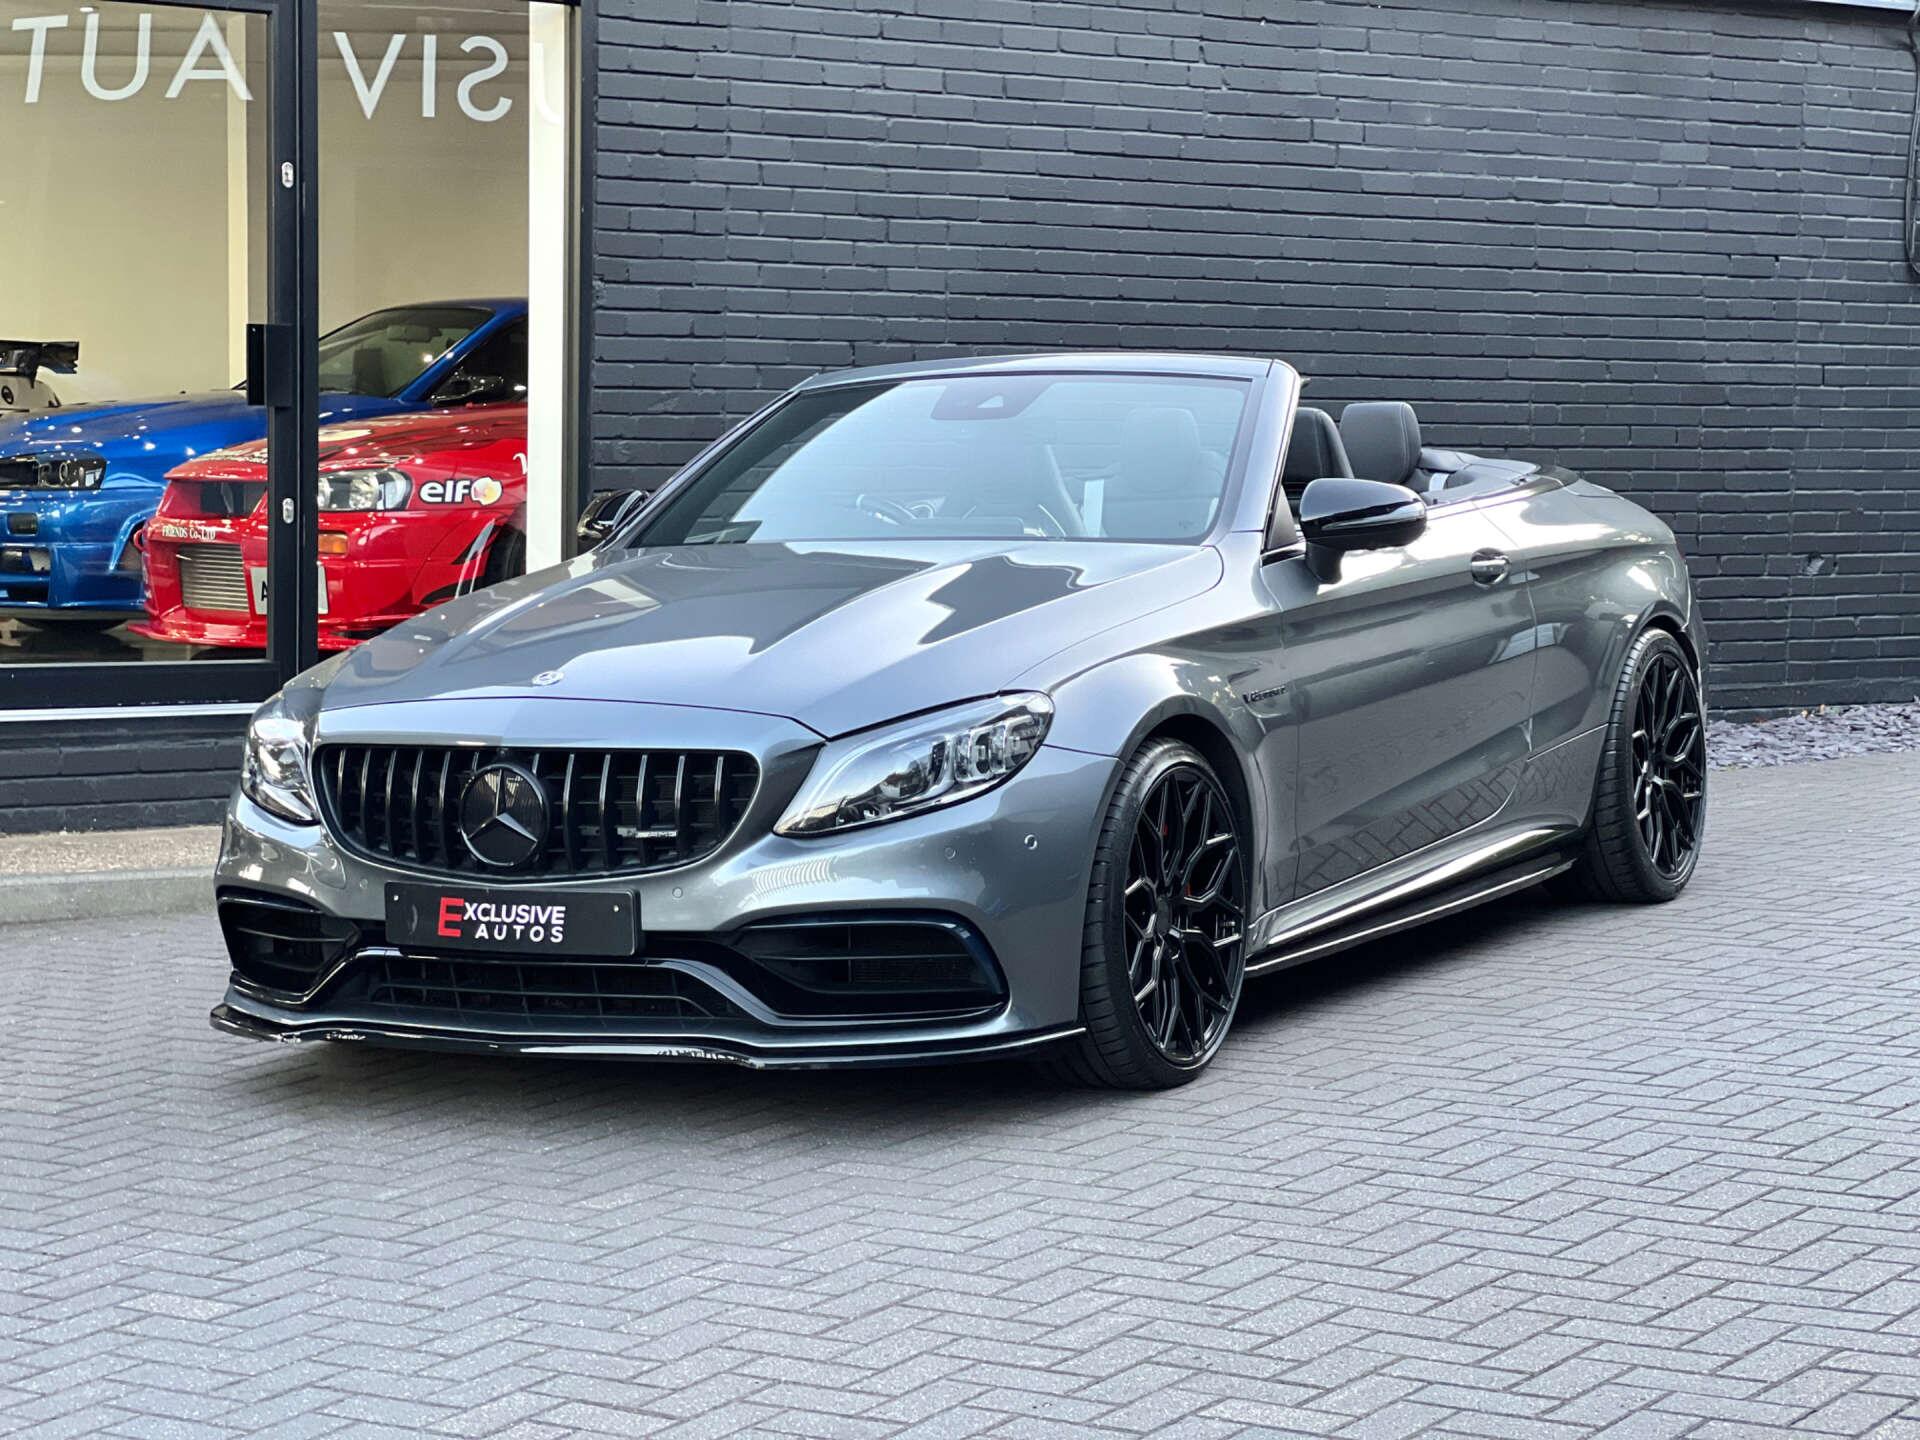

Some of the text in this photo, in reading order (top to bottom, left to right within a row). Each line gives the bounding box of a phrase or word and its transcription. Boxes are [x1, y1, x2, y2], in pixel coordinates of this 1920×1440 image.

[419, 479, 471, 503] elf
[162, 524, 188, 538] FRIENDS
[437, 896, 566, 938] EXCLUSIVE
[474, 923, 564, 943] AUTOS
